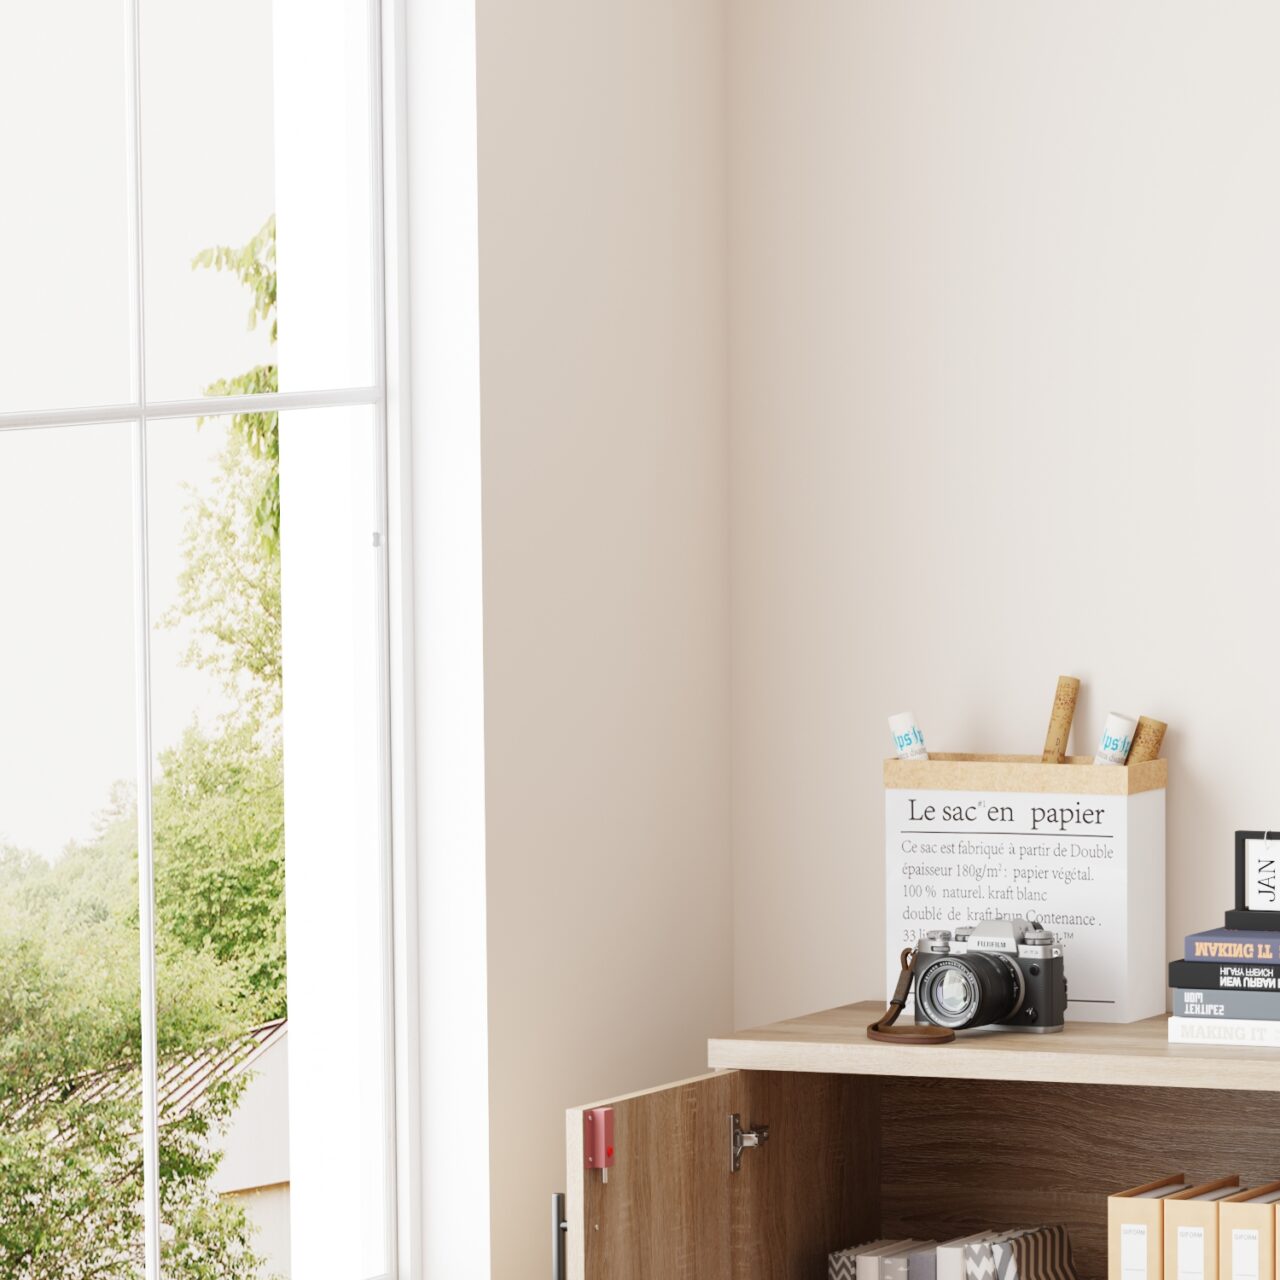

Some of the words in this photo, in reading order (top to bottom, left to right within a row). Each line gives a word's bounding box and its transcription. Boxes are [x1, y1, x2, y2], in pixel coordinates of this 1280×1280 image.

[908, 799, 936, 821] Le
[987, 806, 1015, 823] en
[1031, 801, 1106, 831] papier
[901, 840, 918, 854] Ce
[920, 843, 938, 855] sac
[940, 842, 956, 855] est
[957, 840, 1005, 859] fabriqué
[1008, 841, 1016, 856] à
[1018, 843, 1050, 861] partir
[1053, 841, 1068, 858] de
[1070, 843, 1114, 859] Double
[902, 863, 953, 882] épaisseur
[1013, 865, 1049, 884] papier
[1258, 859, 1276, 903] JAN
[903, 885, 923, 898] 100
[988, 884, 1015, 900] kraft
[1017, 885, 1048, 901] blanc
[902, 906, 943, 921] doublé
[947, 906, 961, 922] de
[966, 907, 994, 922] kraft
[903, 929, 916, 942] 33
[1180, 1024, 1246, 1042] MAKING
